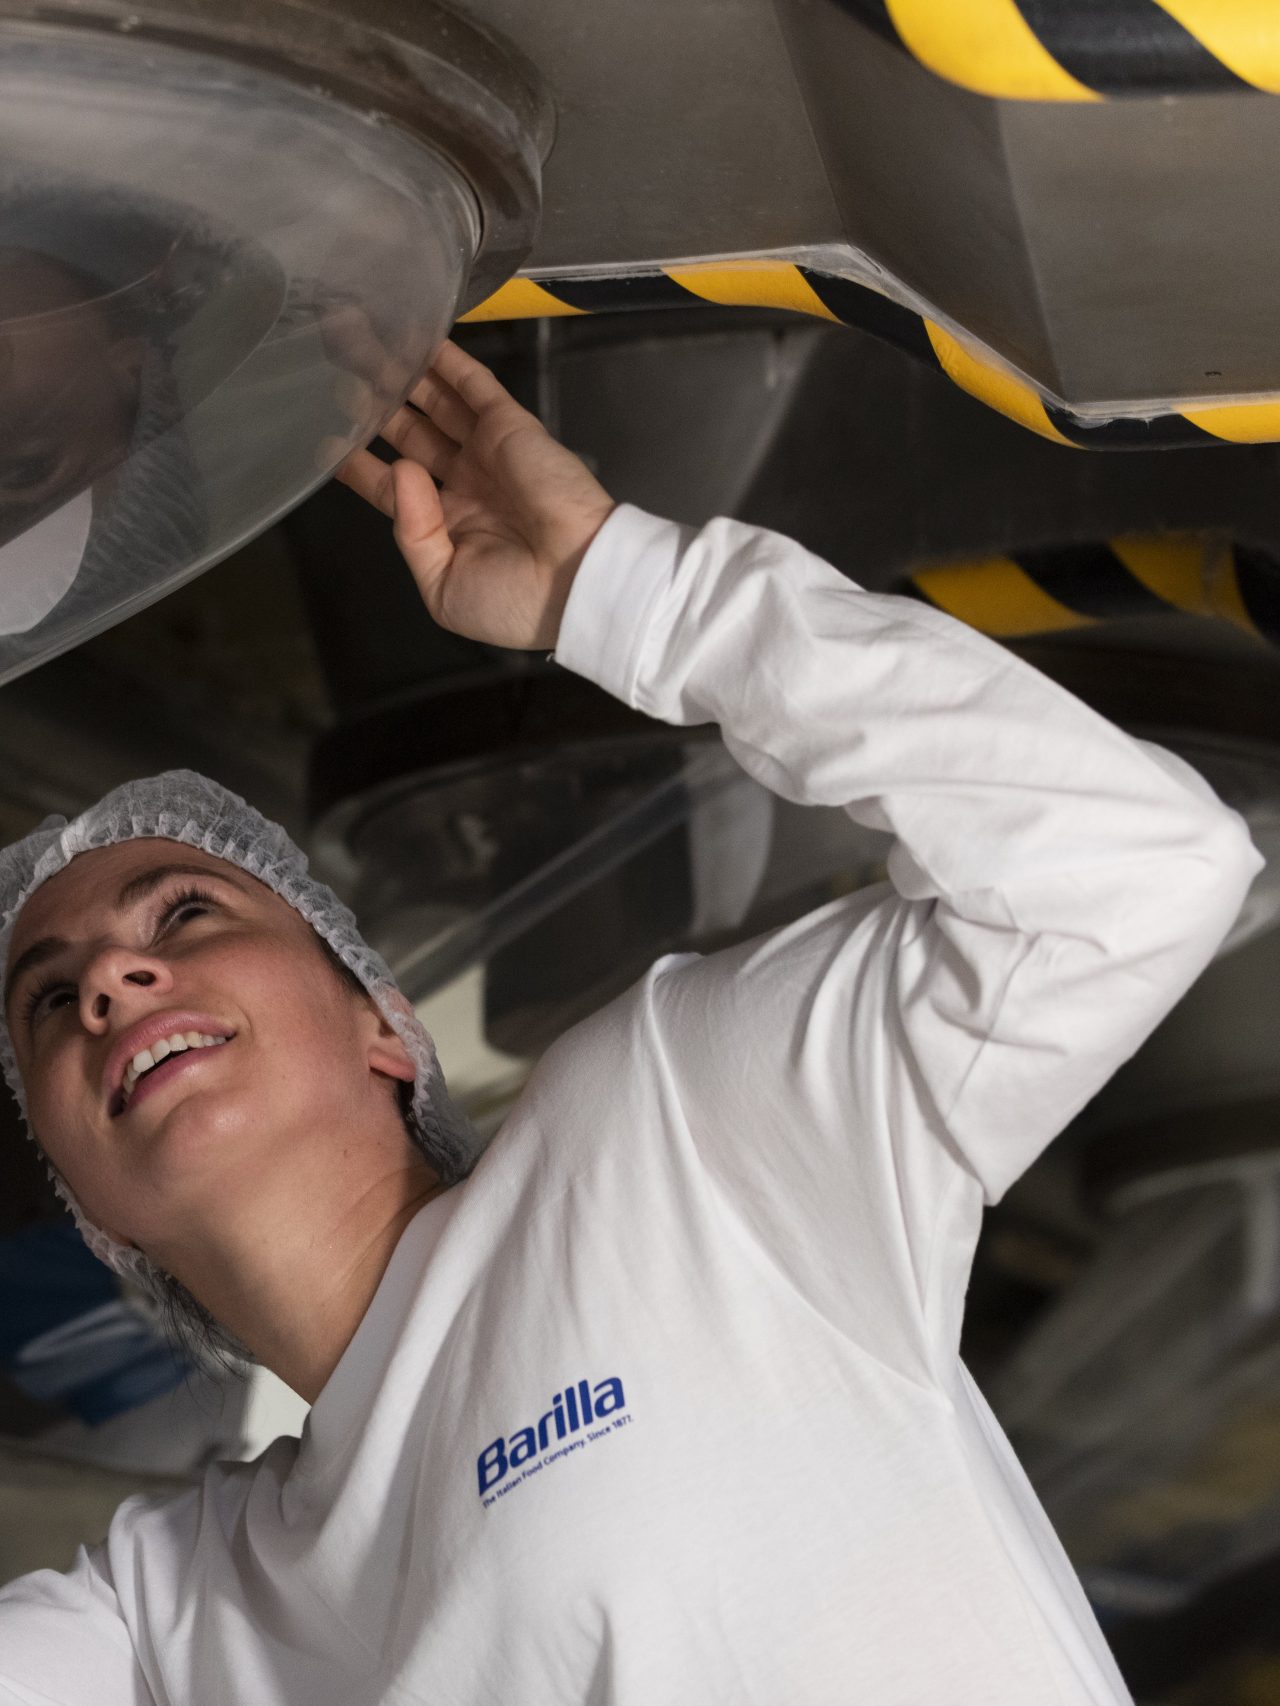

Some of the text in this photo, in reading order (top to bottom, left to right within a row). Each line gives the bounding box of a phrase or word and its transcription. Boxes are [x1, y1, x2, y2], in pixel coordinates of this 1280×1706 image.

[477, 1377, 625, 1497] Barilla
[496, 1476, 522, 1498] Italian
[522, 1462, 543, 1480] Food
[587, 1426, 611, 1442] Since
